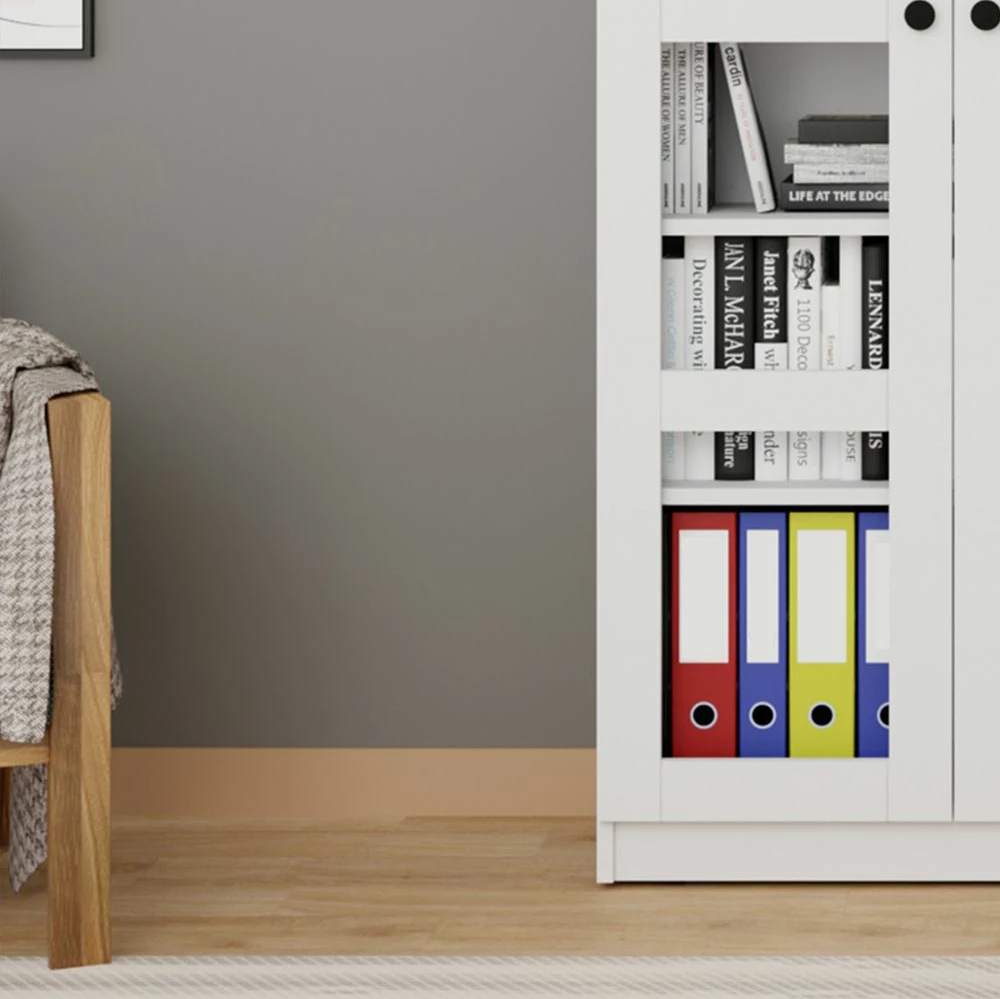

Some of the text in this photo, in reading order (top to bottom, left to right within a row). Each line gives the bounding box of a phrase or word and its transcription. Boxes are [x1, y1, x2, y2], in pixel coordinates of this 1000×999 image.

[694, 42, 704, 125] URE OF BEAUTY
[724, 46, 743, 87] cardin
[661, 49, 671, 162] THE ALLURE OF WOMEN
[677, 49, 686, 146] THE ALLURE OF MEN
[789, 191, 889, 201] LIFE AT THE EDGE
[724, 242, 744, 271] JAN
[690, 259, 707, 345] Decorating
[724, 275, 744, 292] L.
[763, 250, 780, 339] Janet Fitch
[796, 299, 811, 331] 1100
[868, 279, 883, 370] LENNARD
[735, 432, 752, 450] ign
[793, 431, 811, 466] signs
